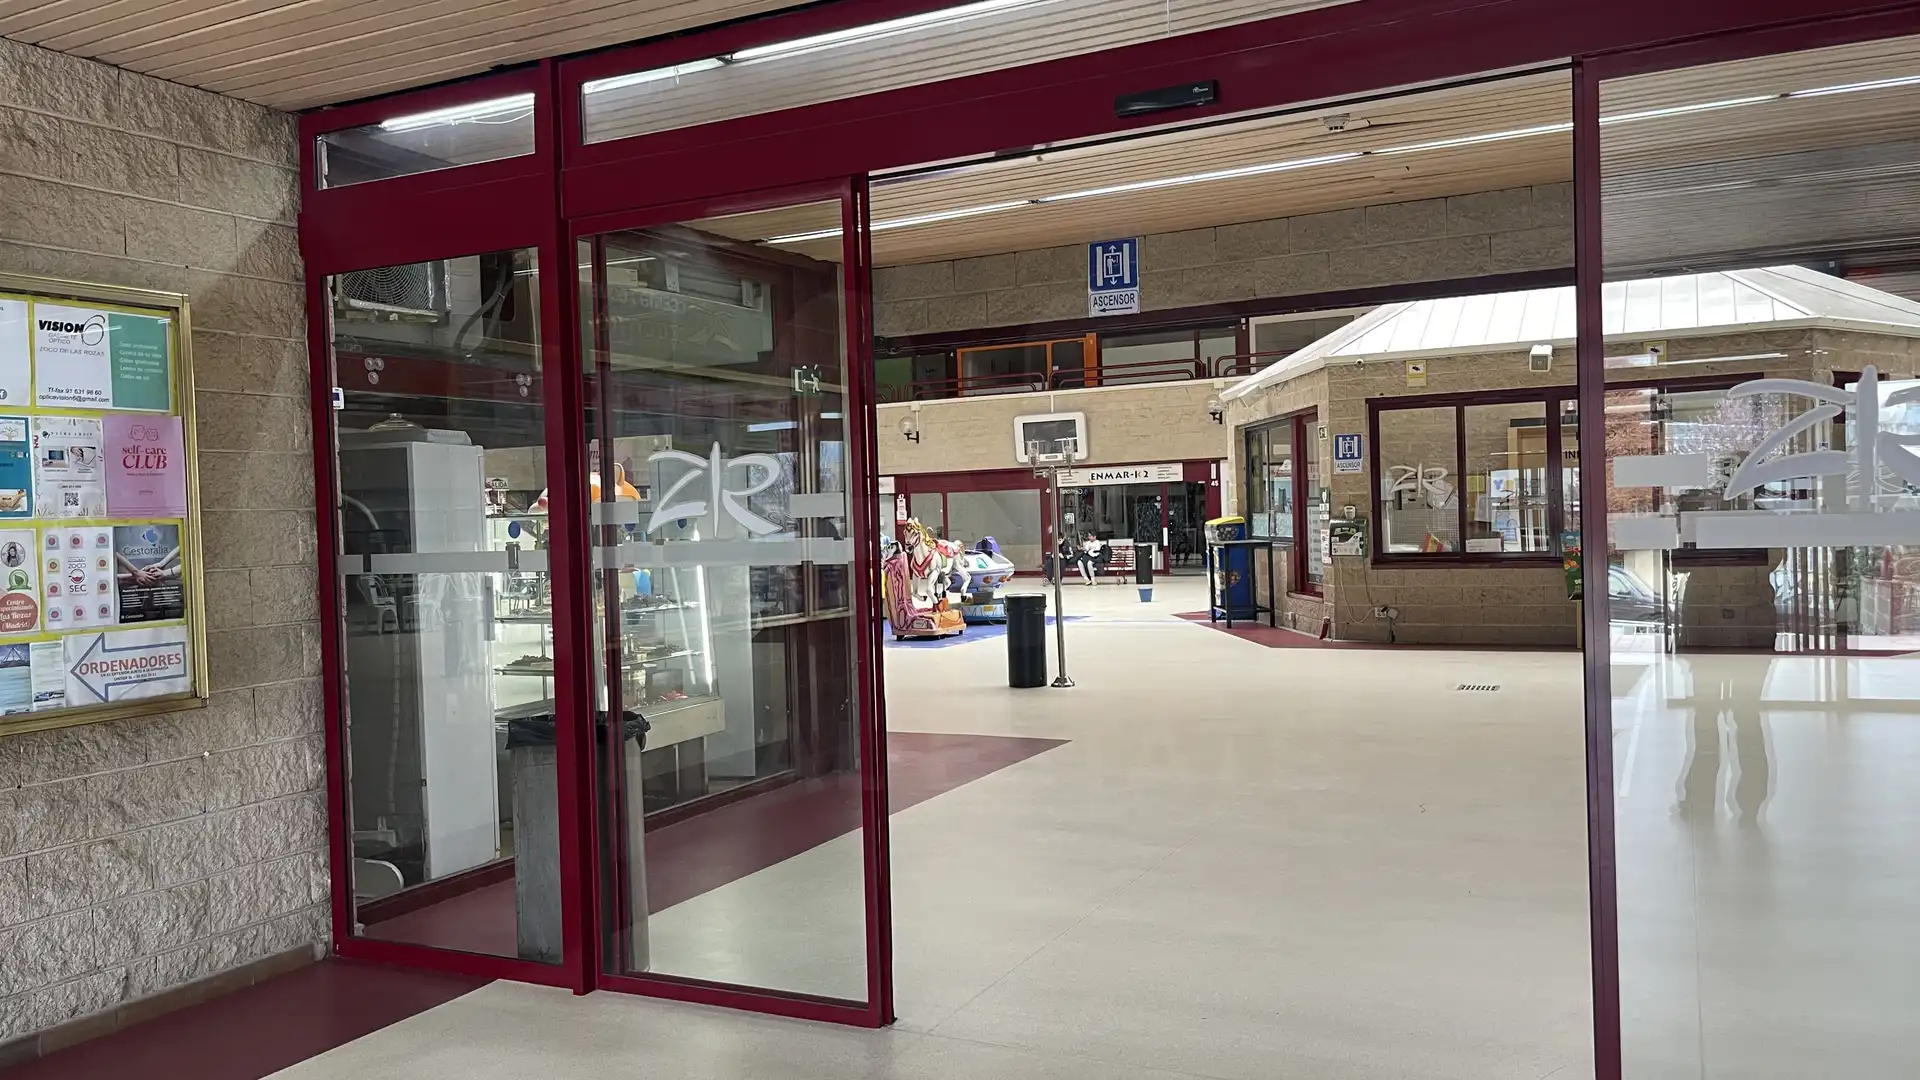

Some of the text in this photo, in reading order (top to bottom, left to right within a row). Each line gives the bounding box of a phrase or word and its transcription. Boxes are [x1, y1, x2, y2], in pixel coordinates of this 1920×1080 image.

[1093, 293, 1135, 307] ASCENSOR
[38, 319, 85, 333] VISION
[122, 444, 167, 455] self-care
[122, 454, 167, 469] CLUB
[69, 584, 87, 593] SEC
[79, 652, 182, 676] ORDENADORES
